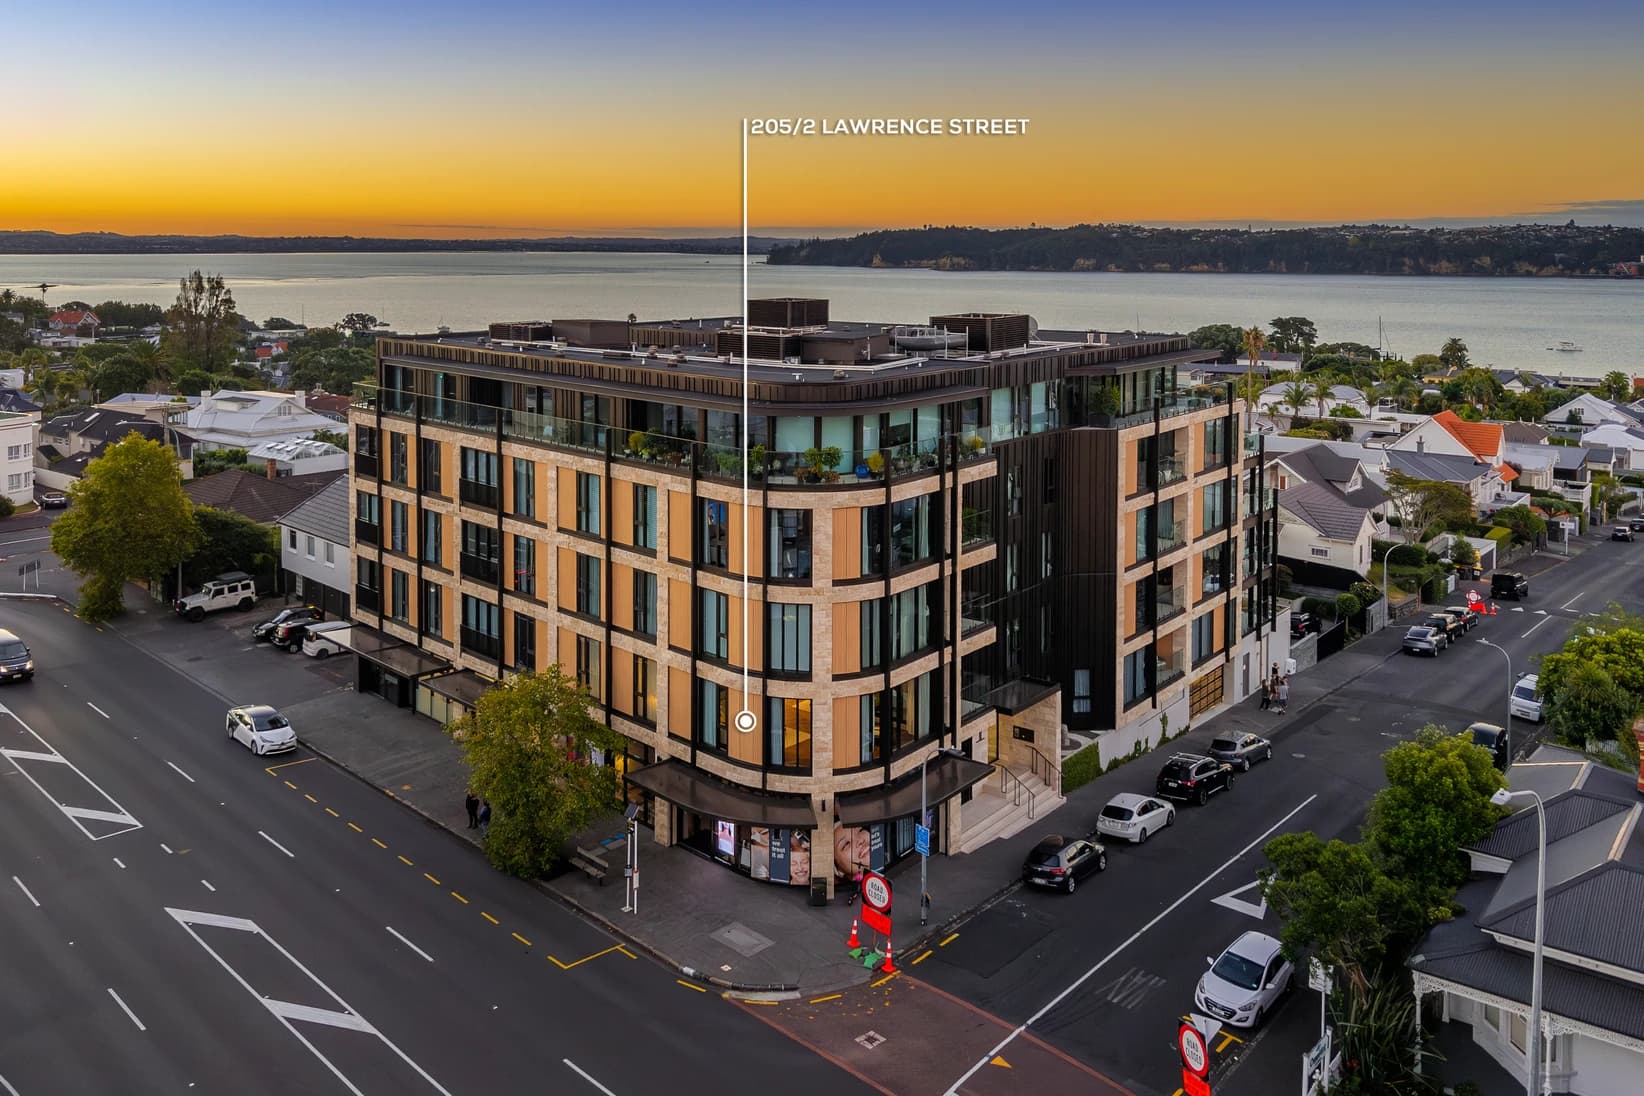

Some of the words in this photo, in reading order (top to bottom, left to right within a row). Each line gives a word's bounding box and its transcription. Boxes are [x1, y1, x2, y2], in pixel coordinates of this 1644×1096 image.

[870, 881, 884, 894] ROAD
[868, 888, 886, 904] CLOSED
[1186, 1037, 1199, 1052] ROAD
[1185, 1047, 1203, 1066] CLOSED
